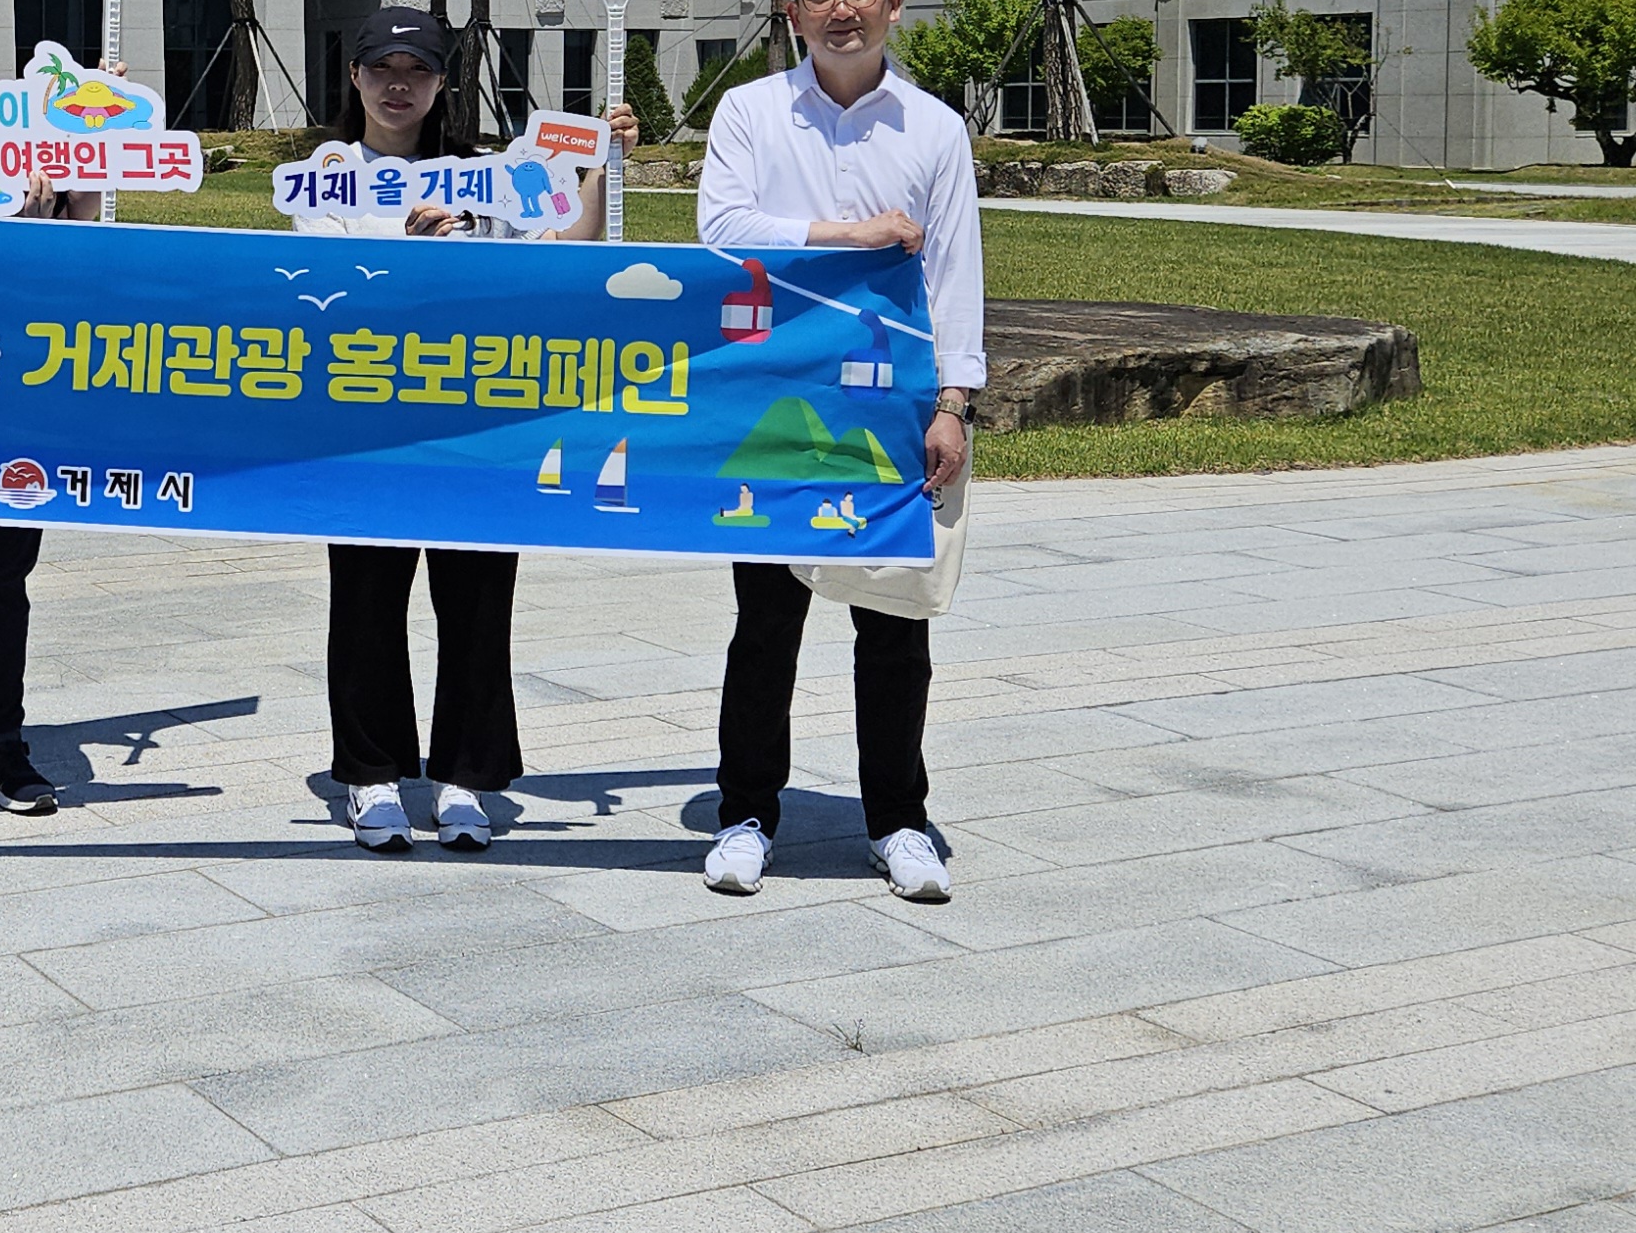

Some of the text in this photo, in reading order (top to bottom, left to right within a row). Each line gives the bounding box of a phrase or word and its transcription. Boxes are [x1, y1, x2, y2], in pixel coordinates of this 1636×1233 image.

[540, 132, 596, 149] welcome
[0, 141, 192, 180] 여행인 그곳
[284, 168, 494, 208] 거제 올 거제
[22, 321, 311, 401] 거제관광
[326, 328, 690, 416] 홍보캠페인
